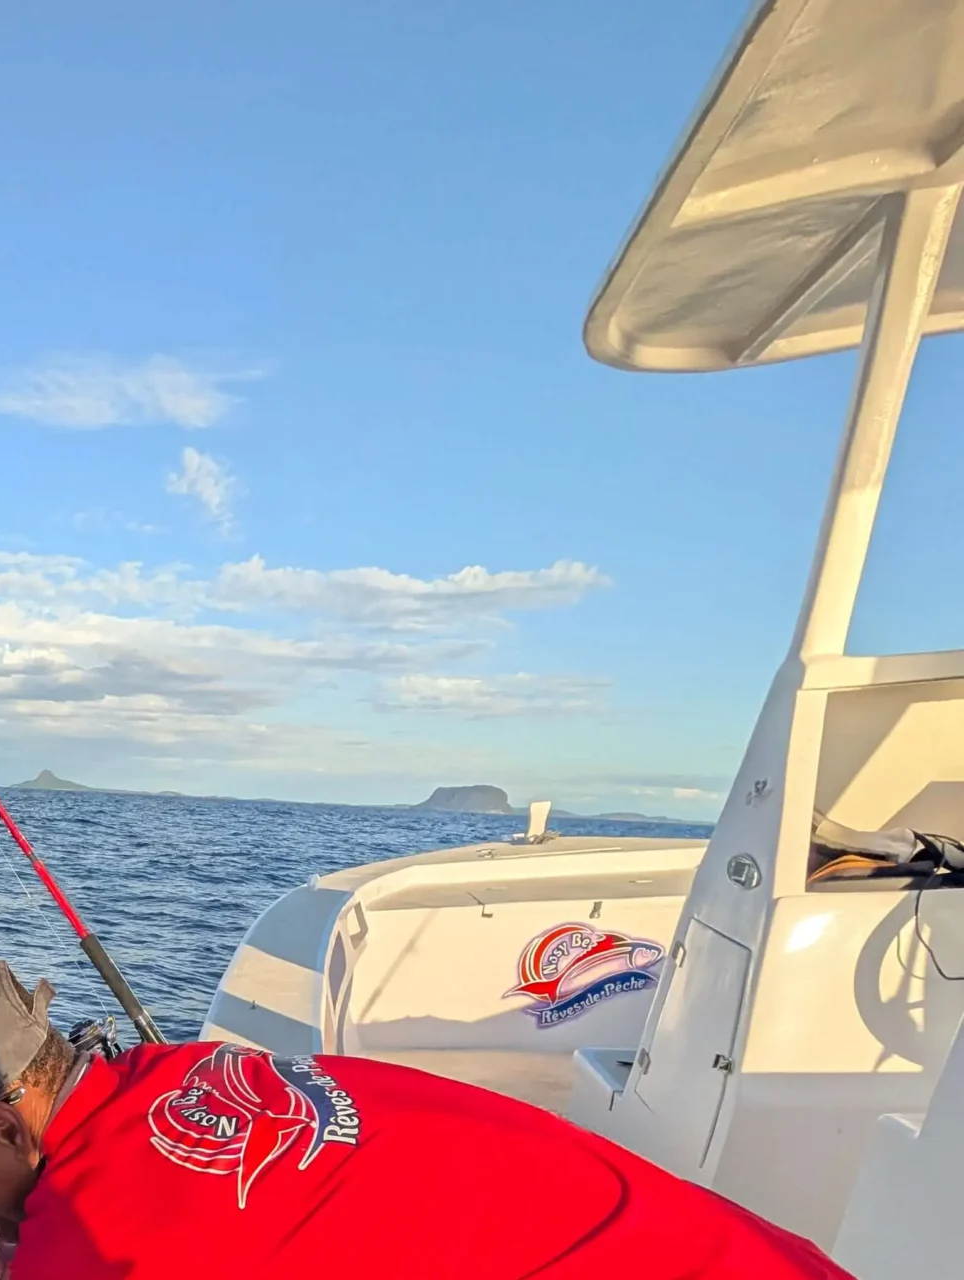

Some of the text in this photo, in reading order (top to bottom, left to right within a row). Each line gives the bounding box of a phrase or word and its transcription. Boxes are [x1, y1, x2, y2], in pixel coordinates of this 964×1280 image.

[542, 933, 591, 975] Nosy Be
[172, 1088, 238, 1137] Nosy Be
